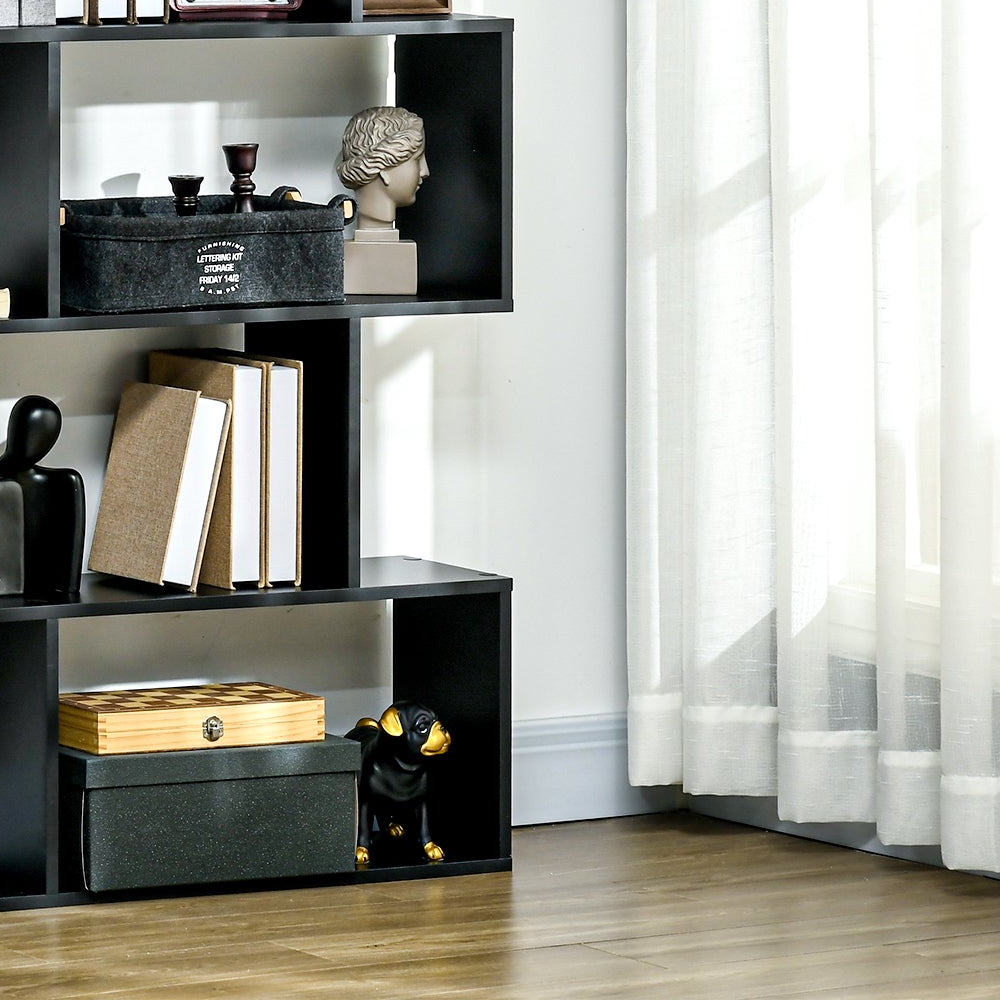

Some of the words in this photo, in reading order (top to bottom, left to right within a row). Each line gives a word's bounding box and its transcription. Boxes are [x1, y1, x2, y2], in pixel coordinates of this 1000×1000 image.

[197, 241, 245, 254] FURNISHING
[196, 253, 231, 263] LETTERING
[232, 252, 243, 261] KIT
[204, 263, 235, 273] STORAGE
[199, 275, 223, 284] FRIDAY
[223, 273, 240, 283] 14/2
